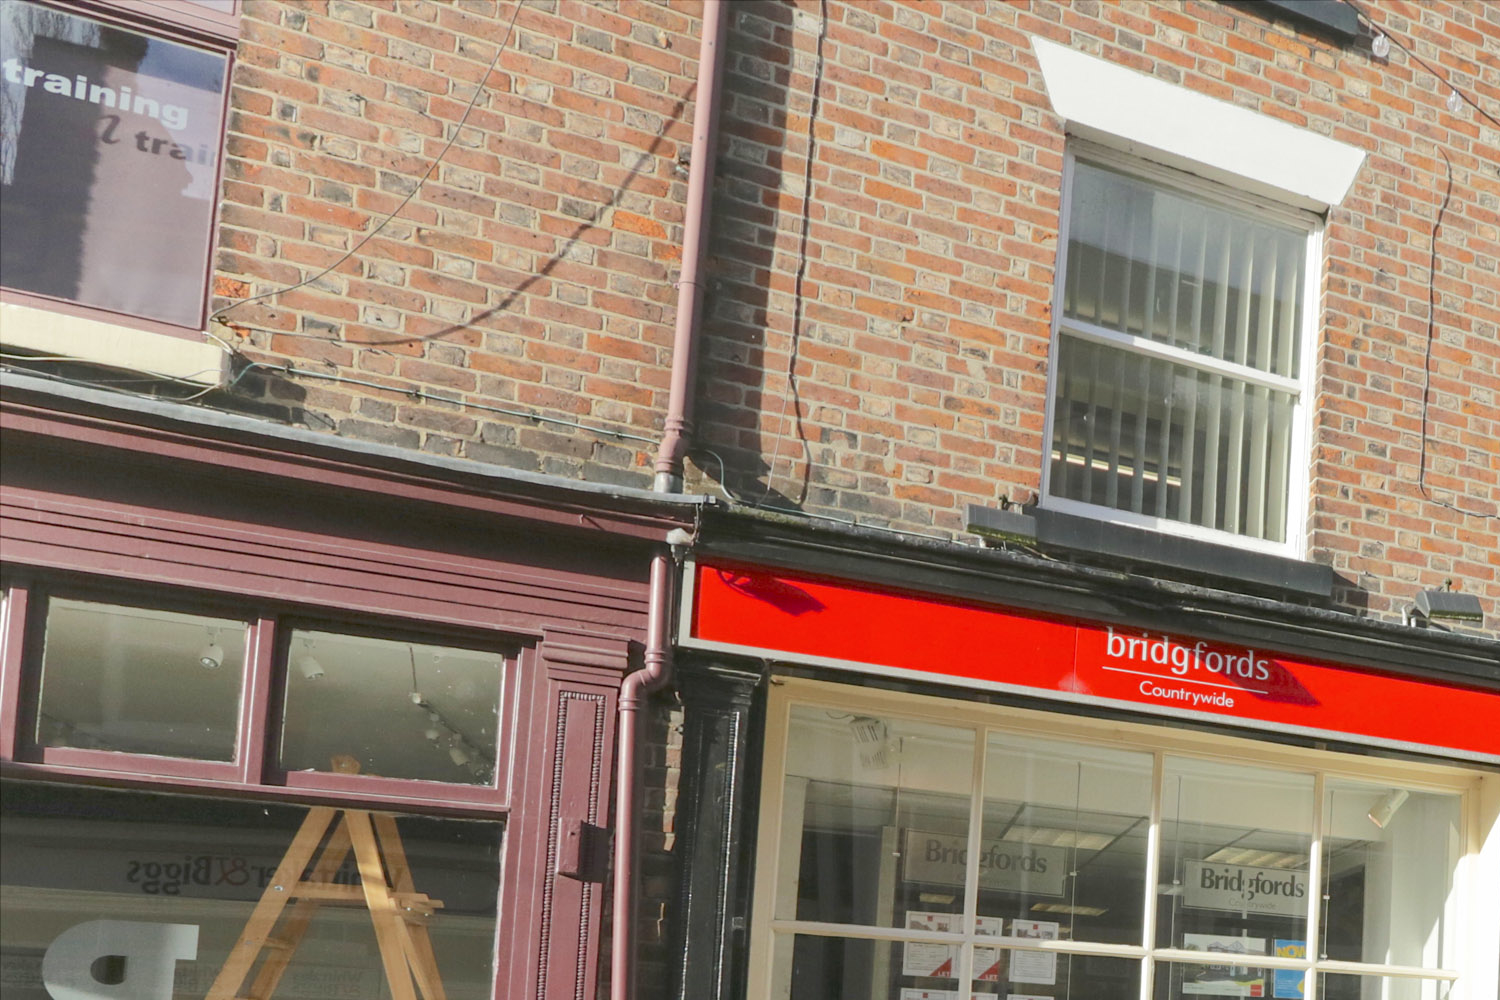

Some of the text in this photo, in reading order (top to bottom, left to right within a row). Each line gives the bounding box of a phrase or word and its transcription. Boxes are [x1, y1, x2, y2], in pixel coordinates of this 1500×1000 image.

[3, 57, 189, 130] training
[1106, 626, 1269, 680] bridgfords
[1139, 680, 1234, 708] Countrywide
